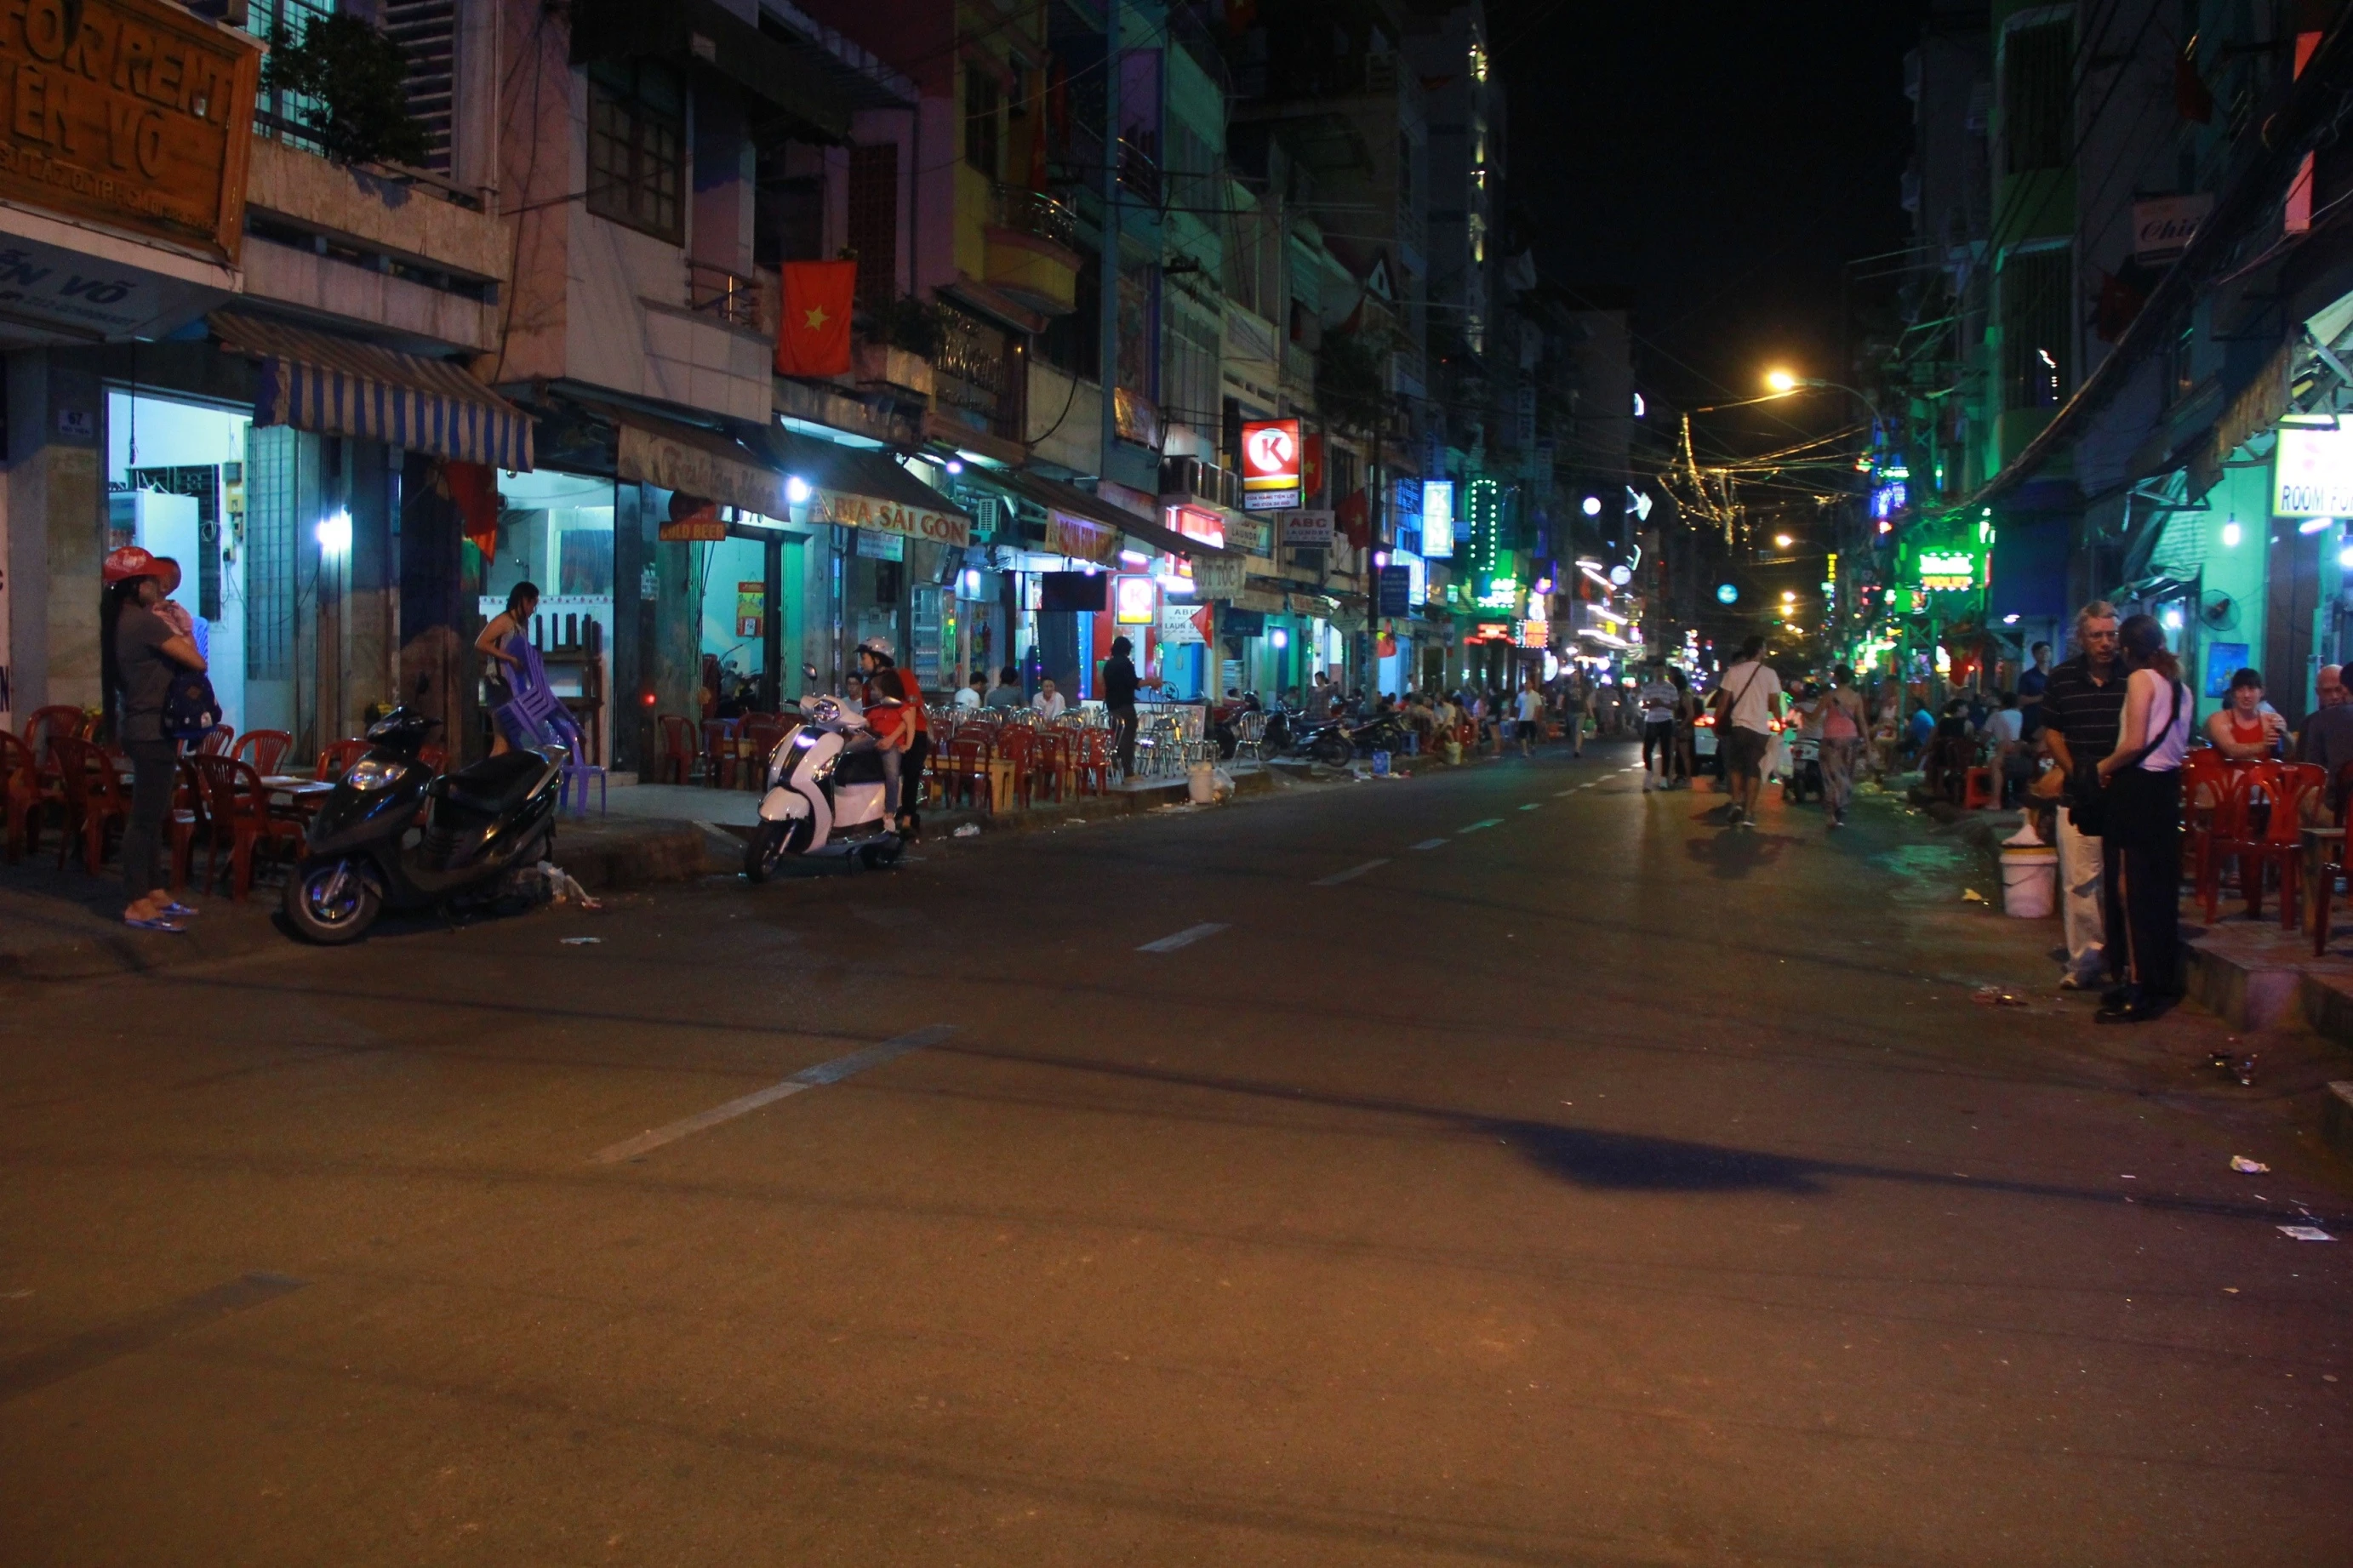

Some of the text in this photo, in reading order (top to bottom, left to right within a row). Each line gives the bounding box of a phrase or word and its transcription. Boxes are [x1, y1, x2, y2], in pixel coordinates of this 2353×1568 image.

[111, 21, 232, 125] RENT
[67, 412, 83, 425] 67
[2282, 485, 2324, 511] ROOM
[921, 512, 965, 543] GÒN
[1289, 517, 1328, 527] ABC
